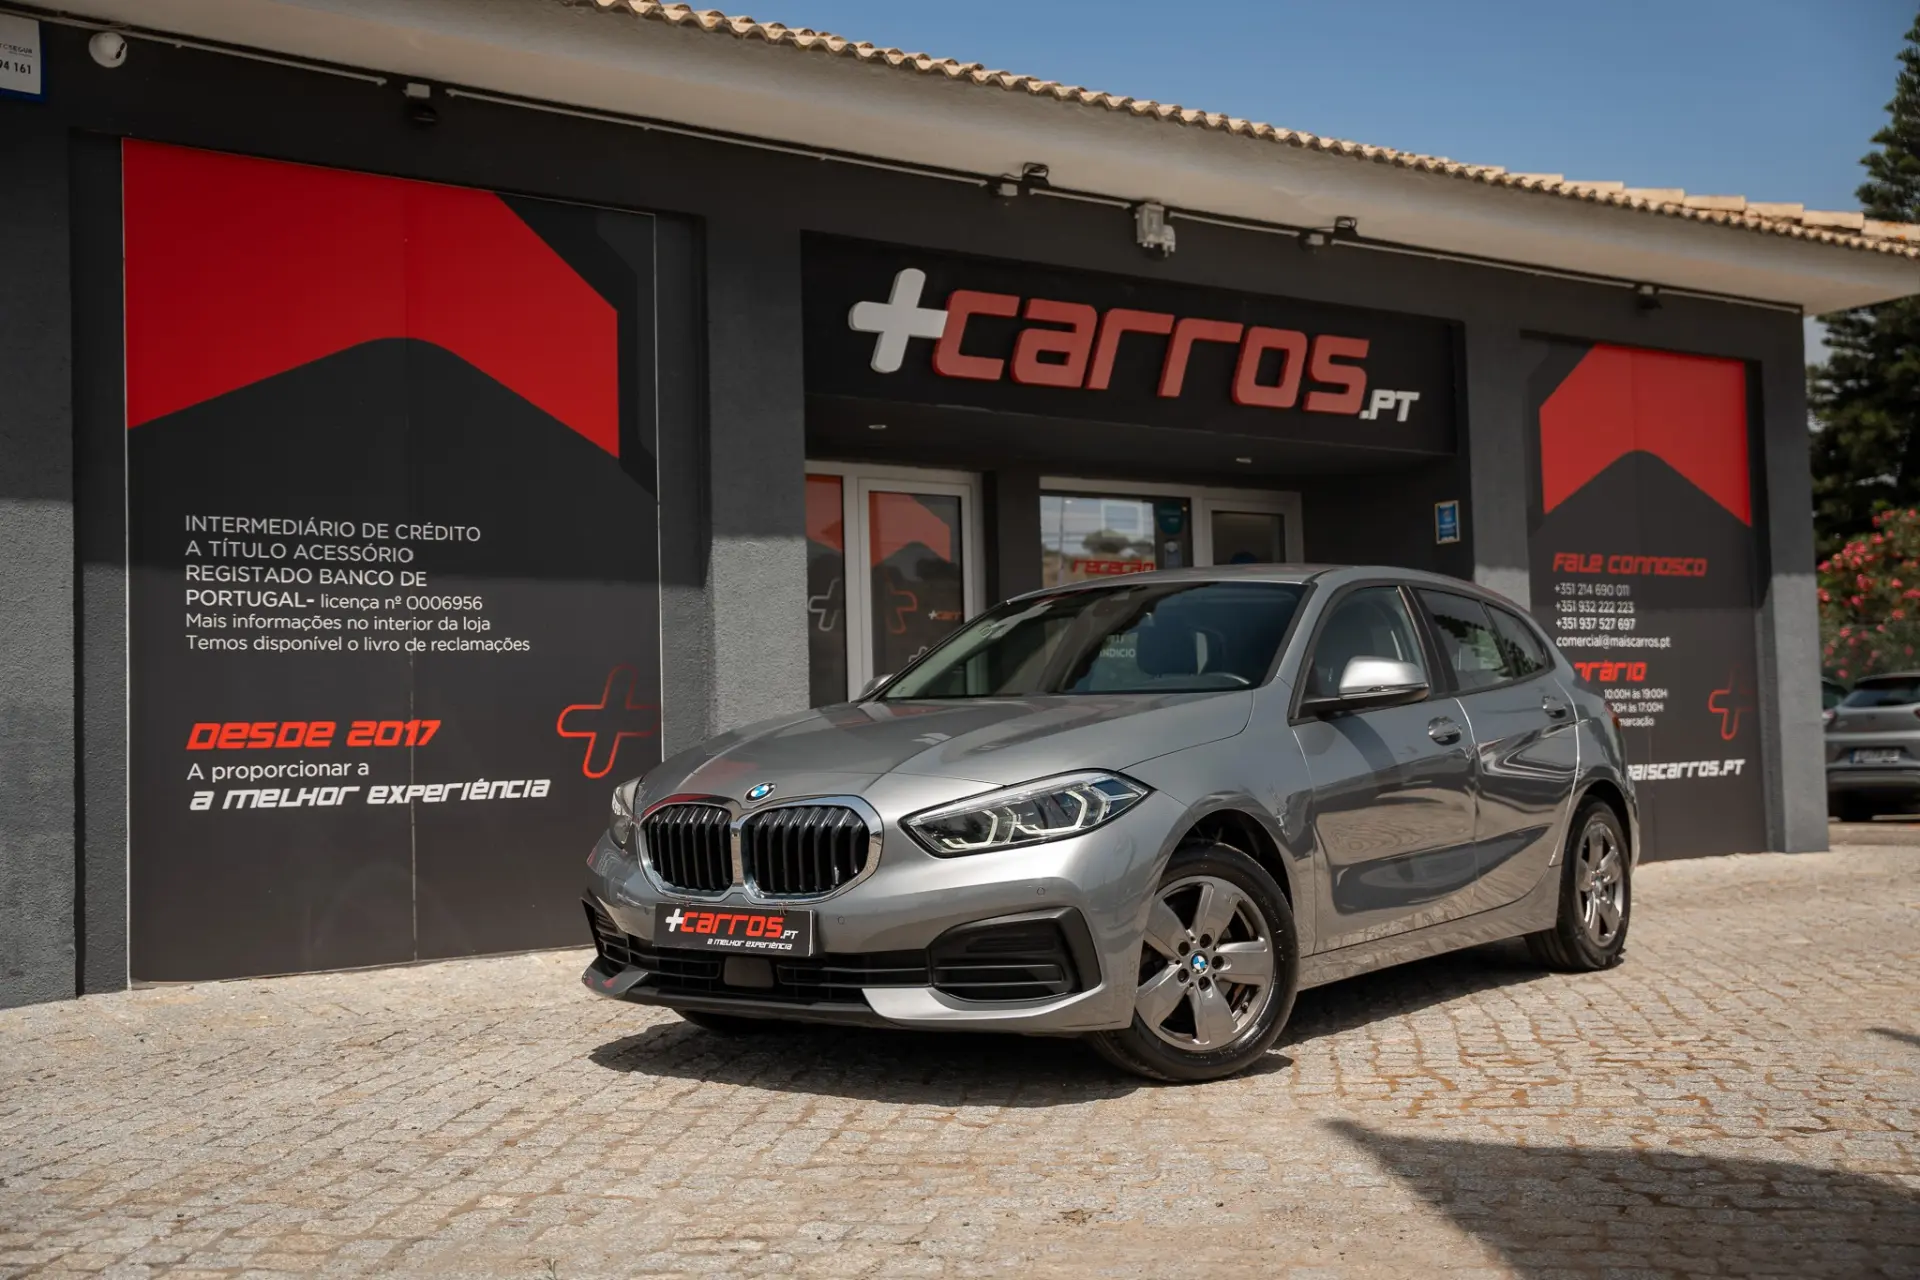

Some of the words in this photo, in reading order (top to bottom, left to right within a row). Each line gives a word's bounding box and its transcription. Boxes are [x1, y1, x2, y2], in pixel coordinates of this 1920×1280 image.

[14, 62, 31, 74] 161
[185, 515, 356, 538] INTERMEDIÁRIO
[362, 522, 389, 539] DE
[395, 521, 481, 542] CRÉDITO
[185, 539, 202, 557] A
[208, 537, 287, 559] TÍTULO
[293, 542, 414, 564] ACESSÓRIO
[185, 564, 313, 584] REGISTADO
[319, 568, 394, 586] BANCO
[400, 571, 428, 587] DE
[186, 589, 315, 608] PORTUGAL-
[320, 593, 380, 611] licença
[384, 595, 402, 610] nº
[406, 595, 483, 611] 0006956
[1554, 582, 1576, 596] +351
[1577, 582, 1594, 596] 214
[1594, 583, 1615, 597] 690
[1615, 583, 1630, 597] 011
[1555, 599, 1577, 613] +351
[1578, 600, 1597, 613] 932
[1597, 601, 1616, 614] 222
[1616, 601, 1635, 614] 223
[186, 612, 227, 629] Mais
[232, 613, 342, 632] informações
[347, 618, 369, 630] no
[373, 615, 434, 631] interior
[437, 616, 459, 631] da
[463, 616, 491, 633] loja
[1555, 616, 1578, 630] +351
[1578, 616, 1597, 630] 937
[1598, 617, 1617, 631] 527
[1617, 617, 1636, 631] 697
[185, 634, 248, 651] Temos
[253, 635, 342, 653] disponível
[347, 639, 359, 651] o
[364, 636, 400, 652] livro
[404, 637, 427, 652] de
[431, 636, 531, 653] reclamações
[1555, 634, 1672, 650] comercial@maiscarros.pt
[346, 719, 441, 747] 2017
[186, 762, 205, 781] A
[211, 759, 352, 783] proporcionar
[357, 762, 369, 776] a
